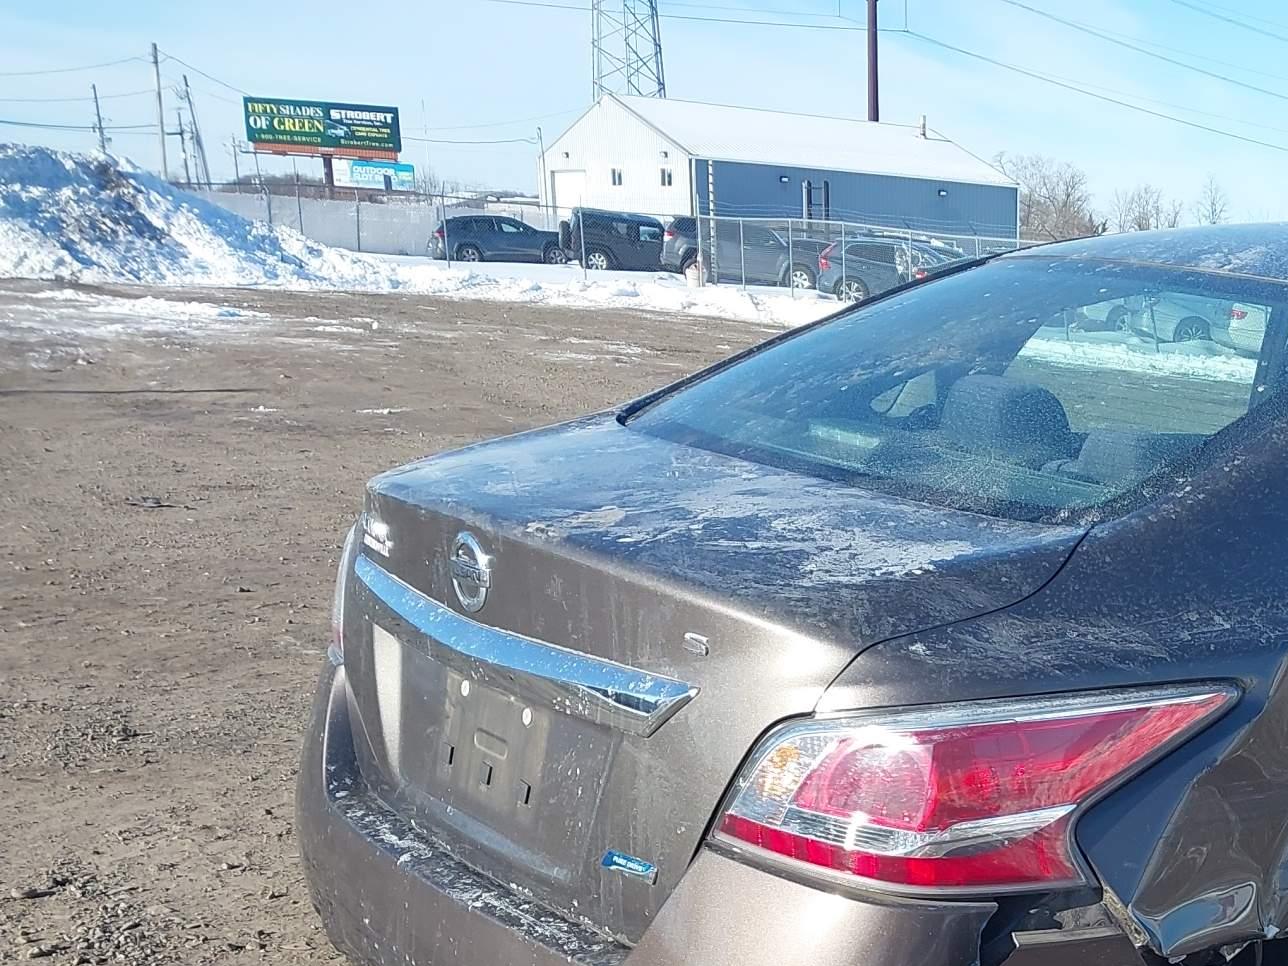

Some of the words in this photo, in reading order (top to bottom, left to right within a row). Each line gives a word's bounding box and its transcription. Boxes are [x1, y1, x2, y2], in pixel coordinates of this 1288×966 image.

[248, 103, 277, 114] FIFTY
[280, 104, 324, 117] SHADES
[330, 109, 394, 124] STROBERT
[249, 115, 271, 130] OF
[273, 117, 324, 132] GREEN
[352, 165, 396, 176] OUTDOOR
